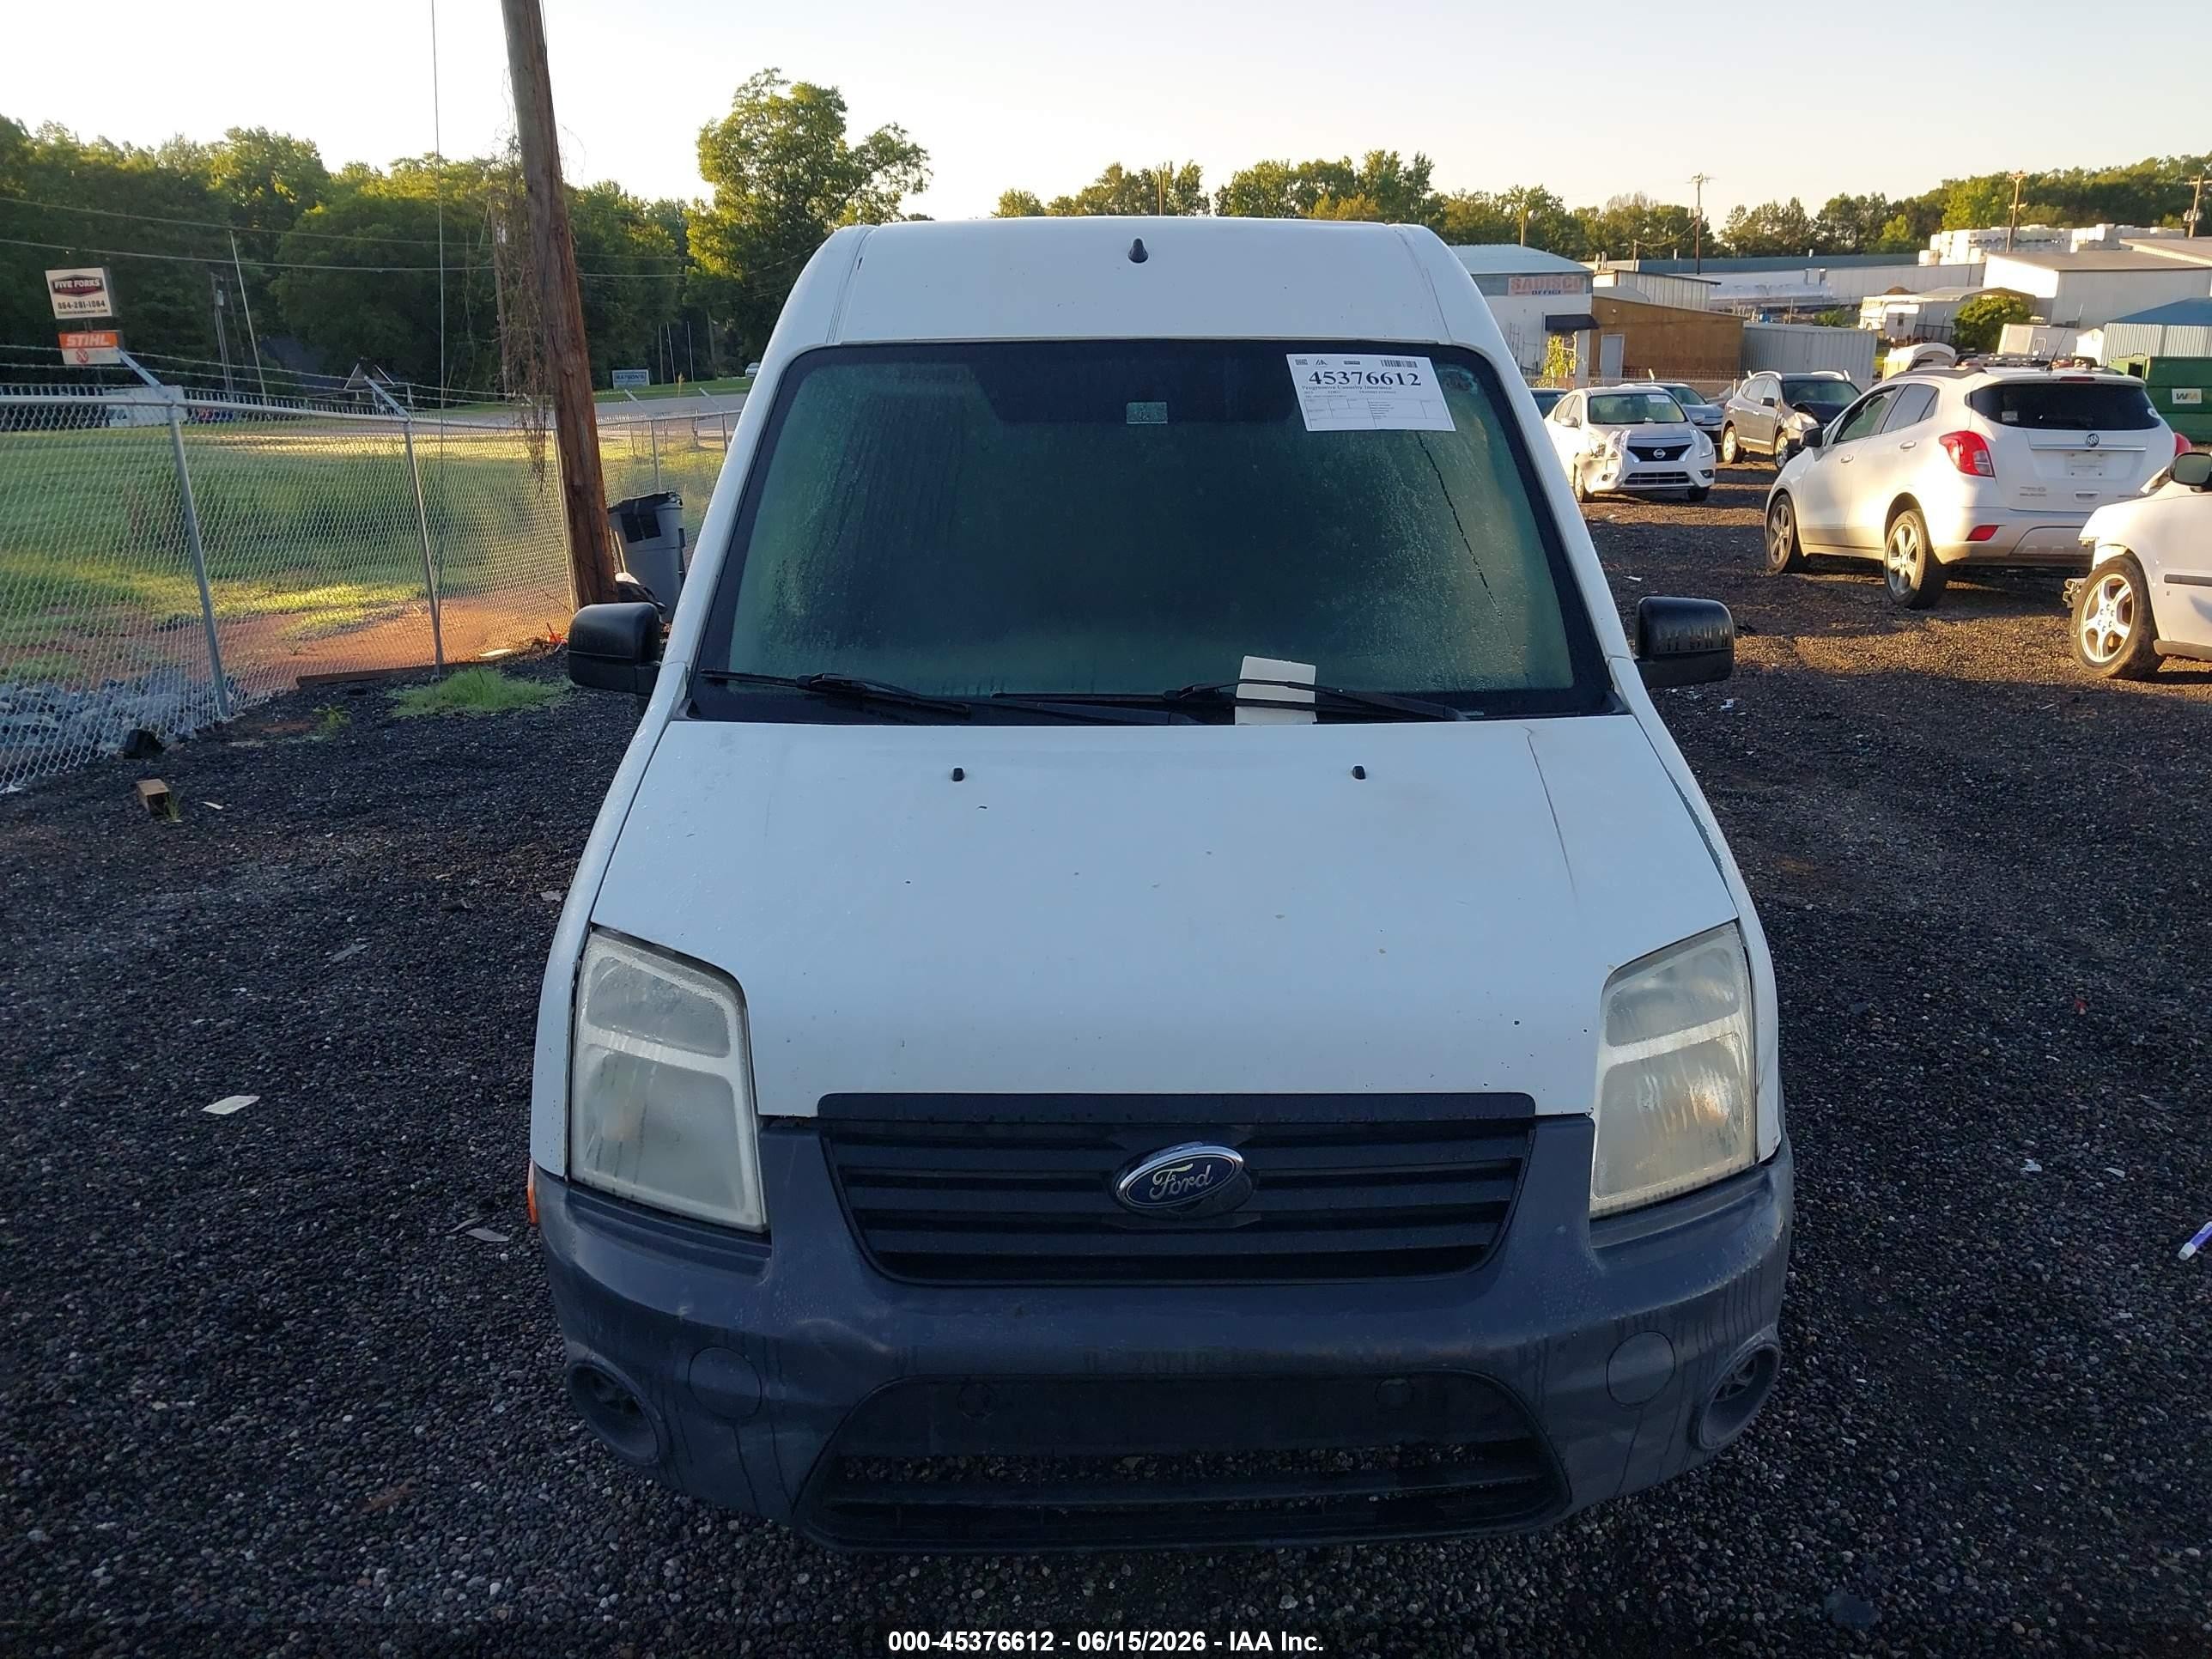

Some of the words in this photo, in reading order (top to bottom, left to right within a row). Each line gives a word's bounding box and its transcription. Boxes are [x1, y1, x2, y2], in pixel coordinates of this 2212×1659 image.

[54, 280, 73, 289] FIVE
[74, 278, 100, 288] FORKS
[66, 335, 109, 346] STIHL
[1309, 370, 1422, 386] 45376612
[1148, 1163, 1214, 1200] Ford
